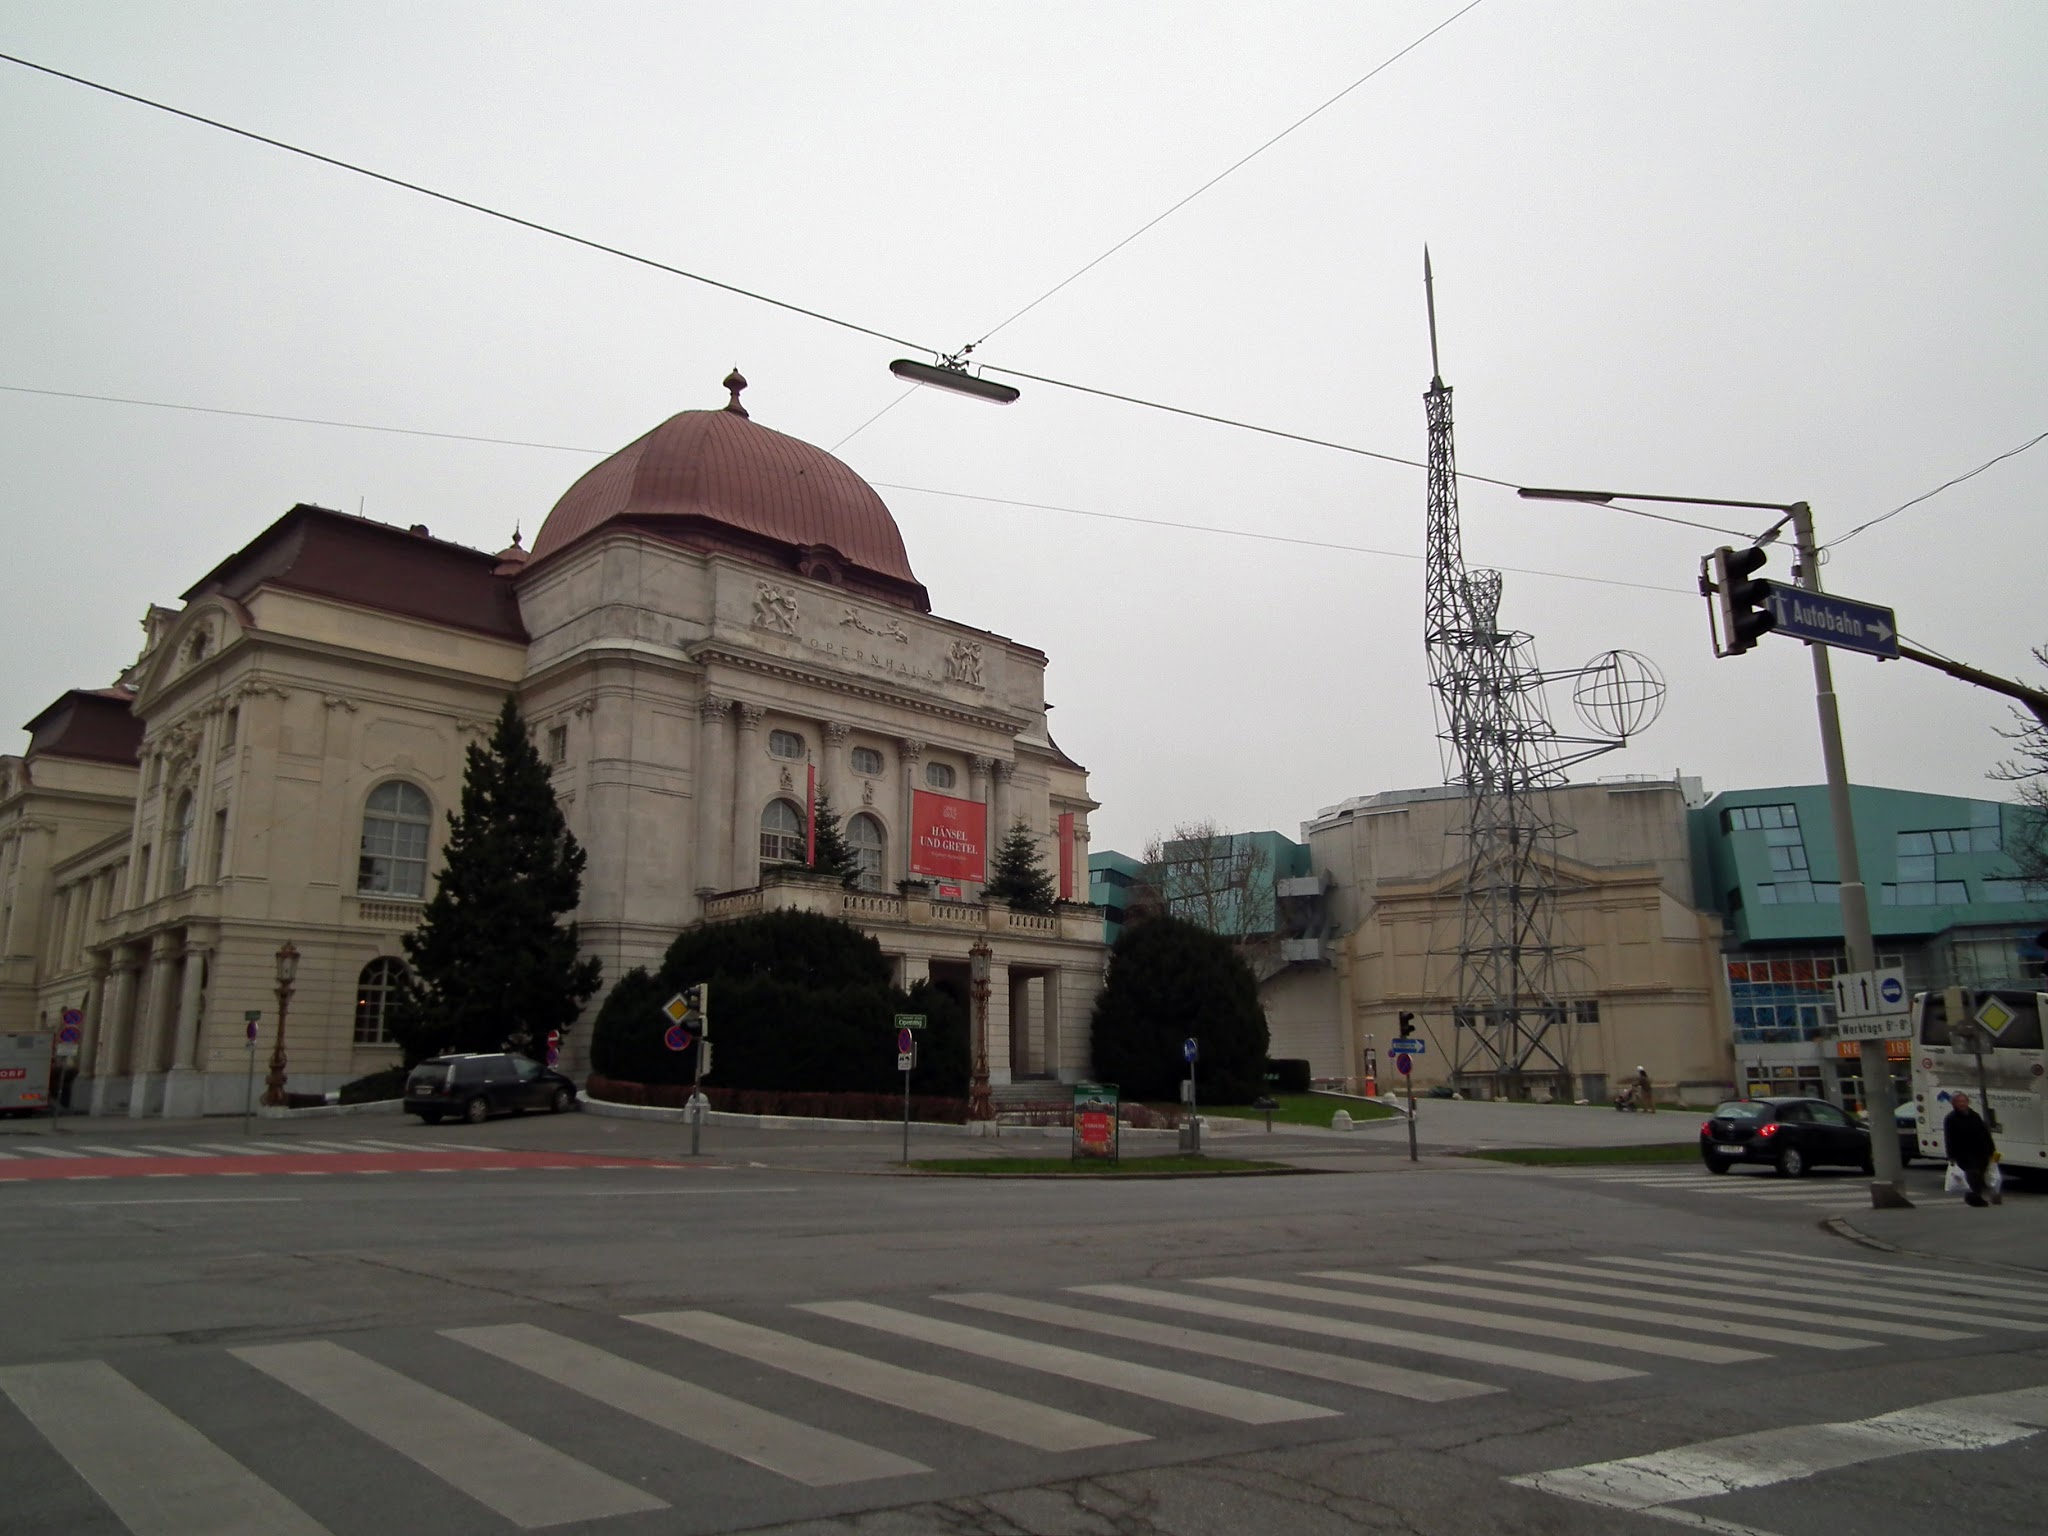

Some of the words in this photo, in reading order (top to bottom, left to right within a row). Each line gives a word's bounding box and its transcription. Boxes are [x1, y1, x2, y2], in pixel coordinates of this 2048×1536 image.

[1793, 599, 1863, 638] Autobahn
[810, 638, 933, 679] OPERNHAUS
[932, 825, 968, 841] HÄNSEL
[920, 836, 940, 848] UND
[942, 840, 978, 855] GRETEL
[1842, 1022, 1882, 1035] Werktags
[1843, 1043, 1860, 1055] NE
[1891, 1042, 1911, 1054] IBE
